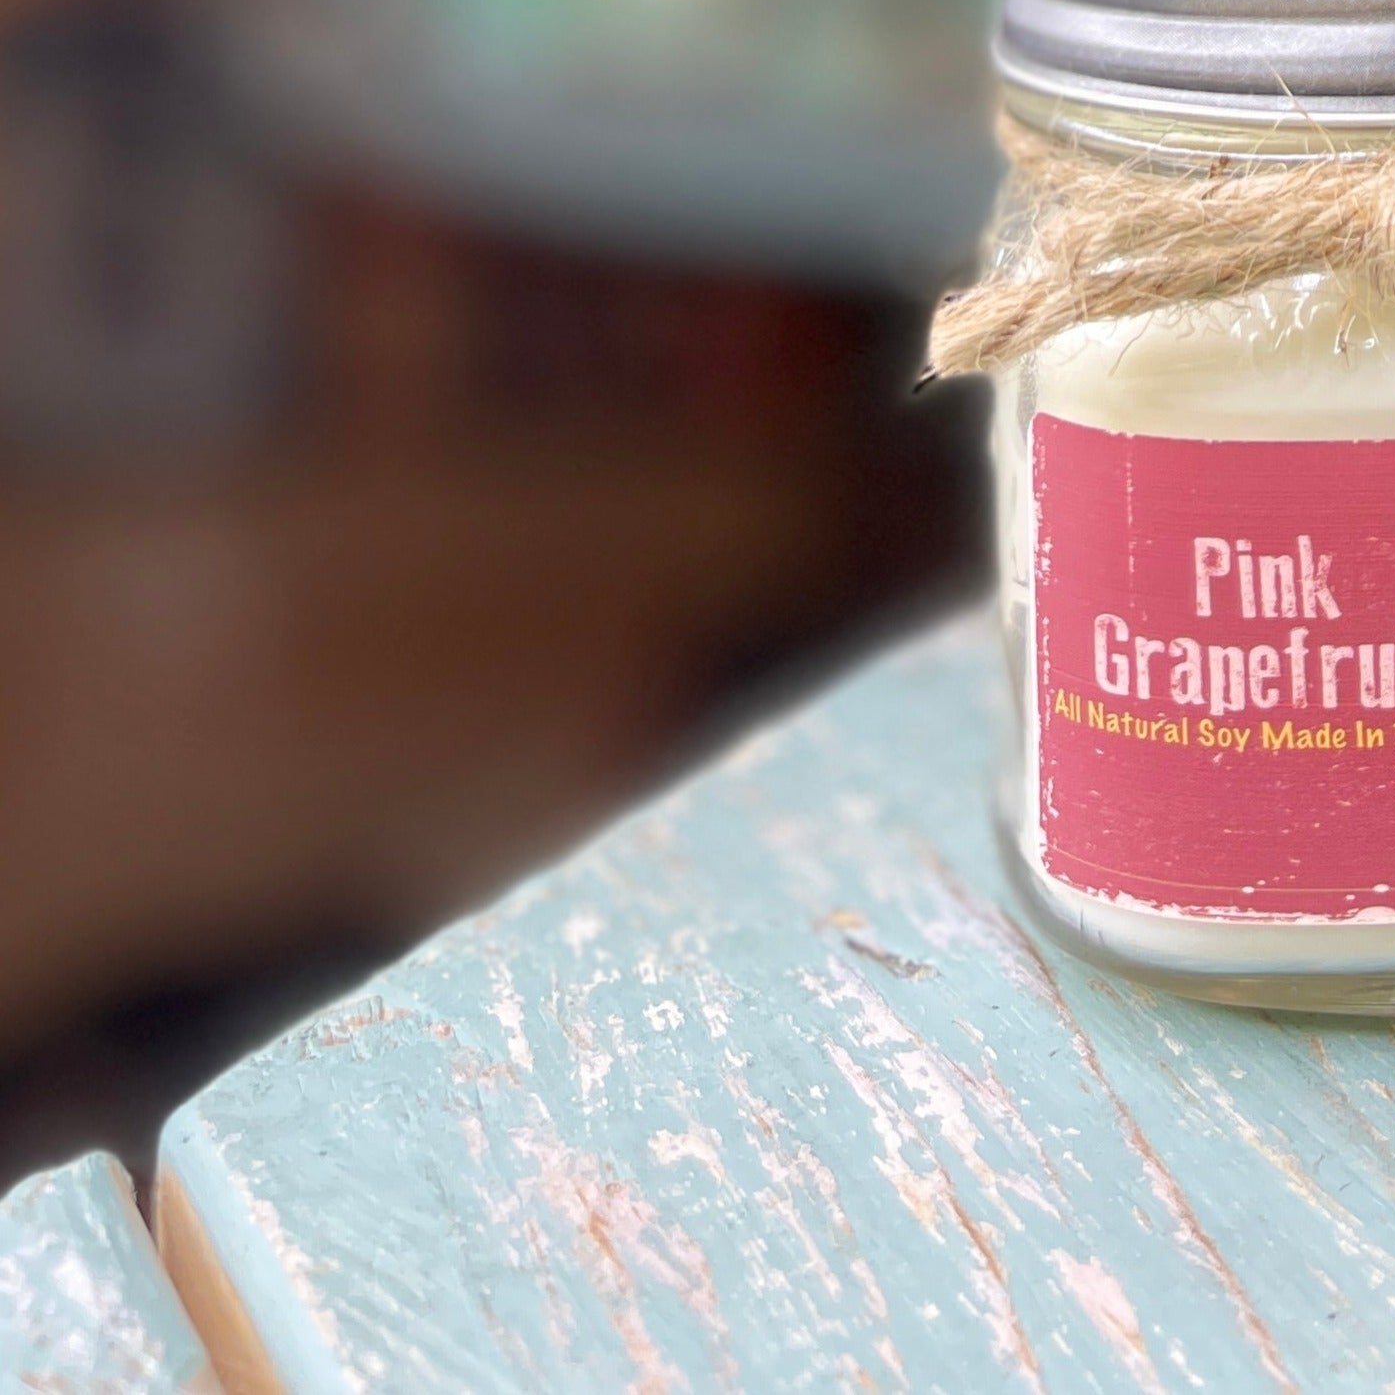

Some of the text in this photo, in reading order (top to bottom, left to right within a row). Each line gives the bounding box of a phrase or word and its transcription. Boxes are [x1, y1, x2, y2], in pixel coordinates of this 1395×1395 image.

[1194, 535, 1342, 620] Pink
[1054, 688, 1082, 722] All
[1088, 701, 1189, 746] Natural
[1198, 719, 1250, 750] Soy
[1262, 720, 1348, 752] Made
[1356, 718, 1384, 747] In
